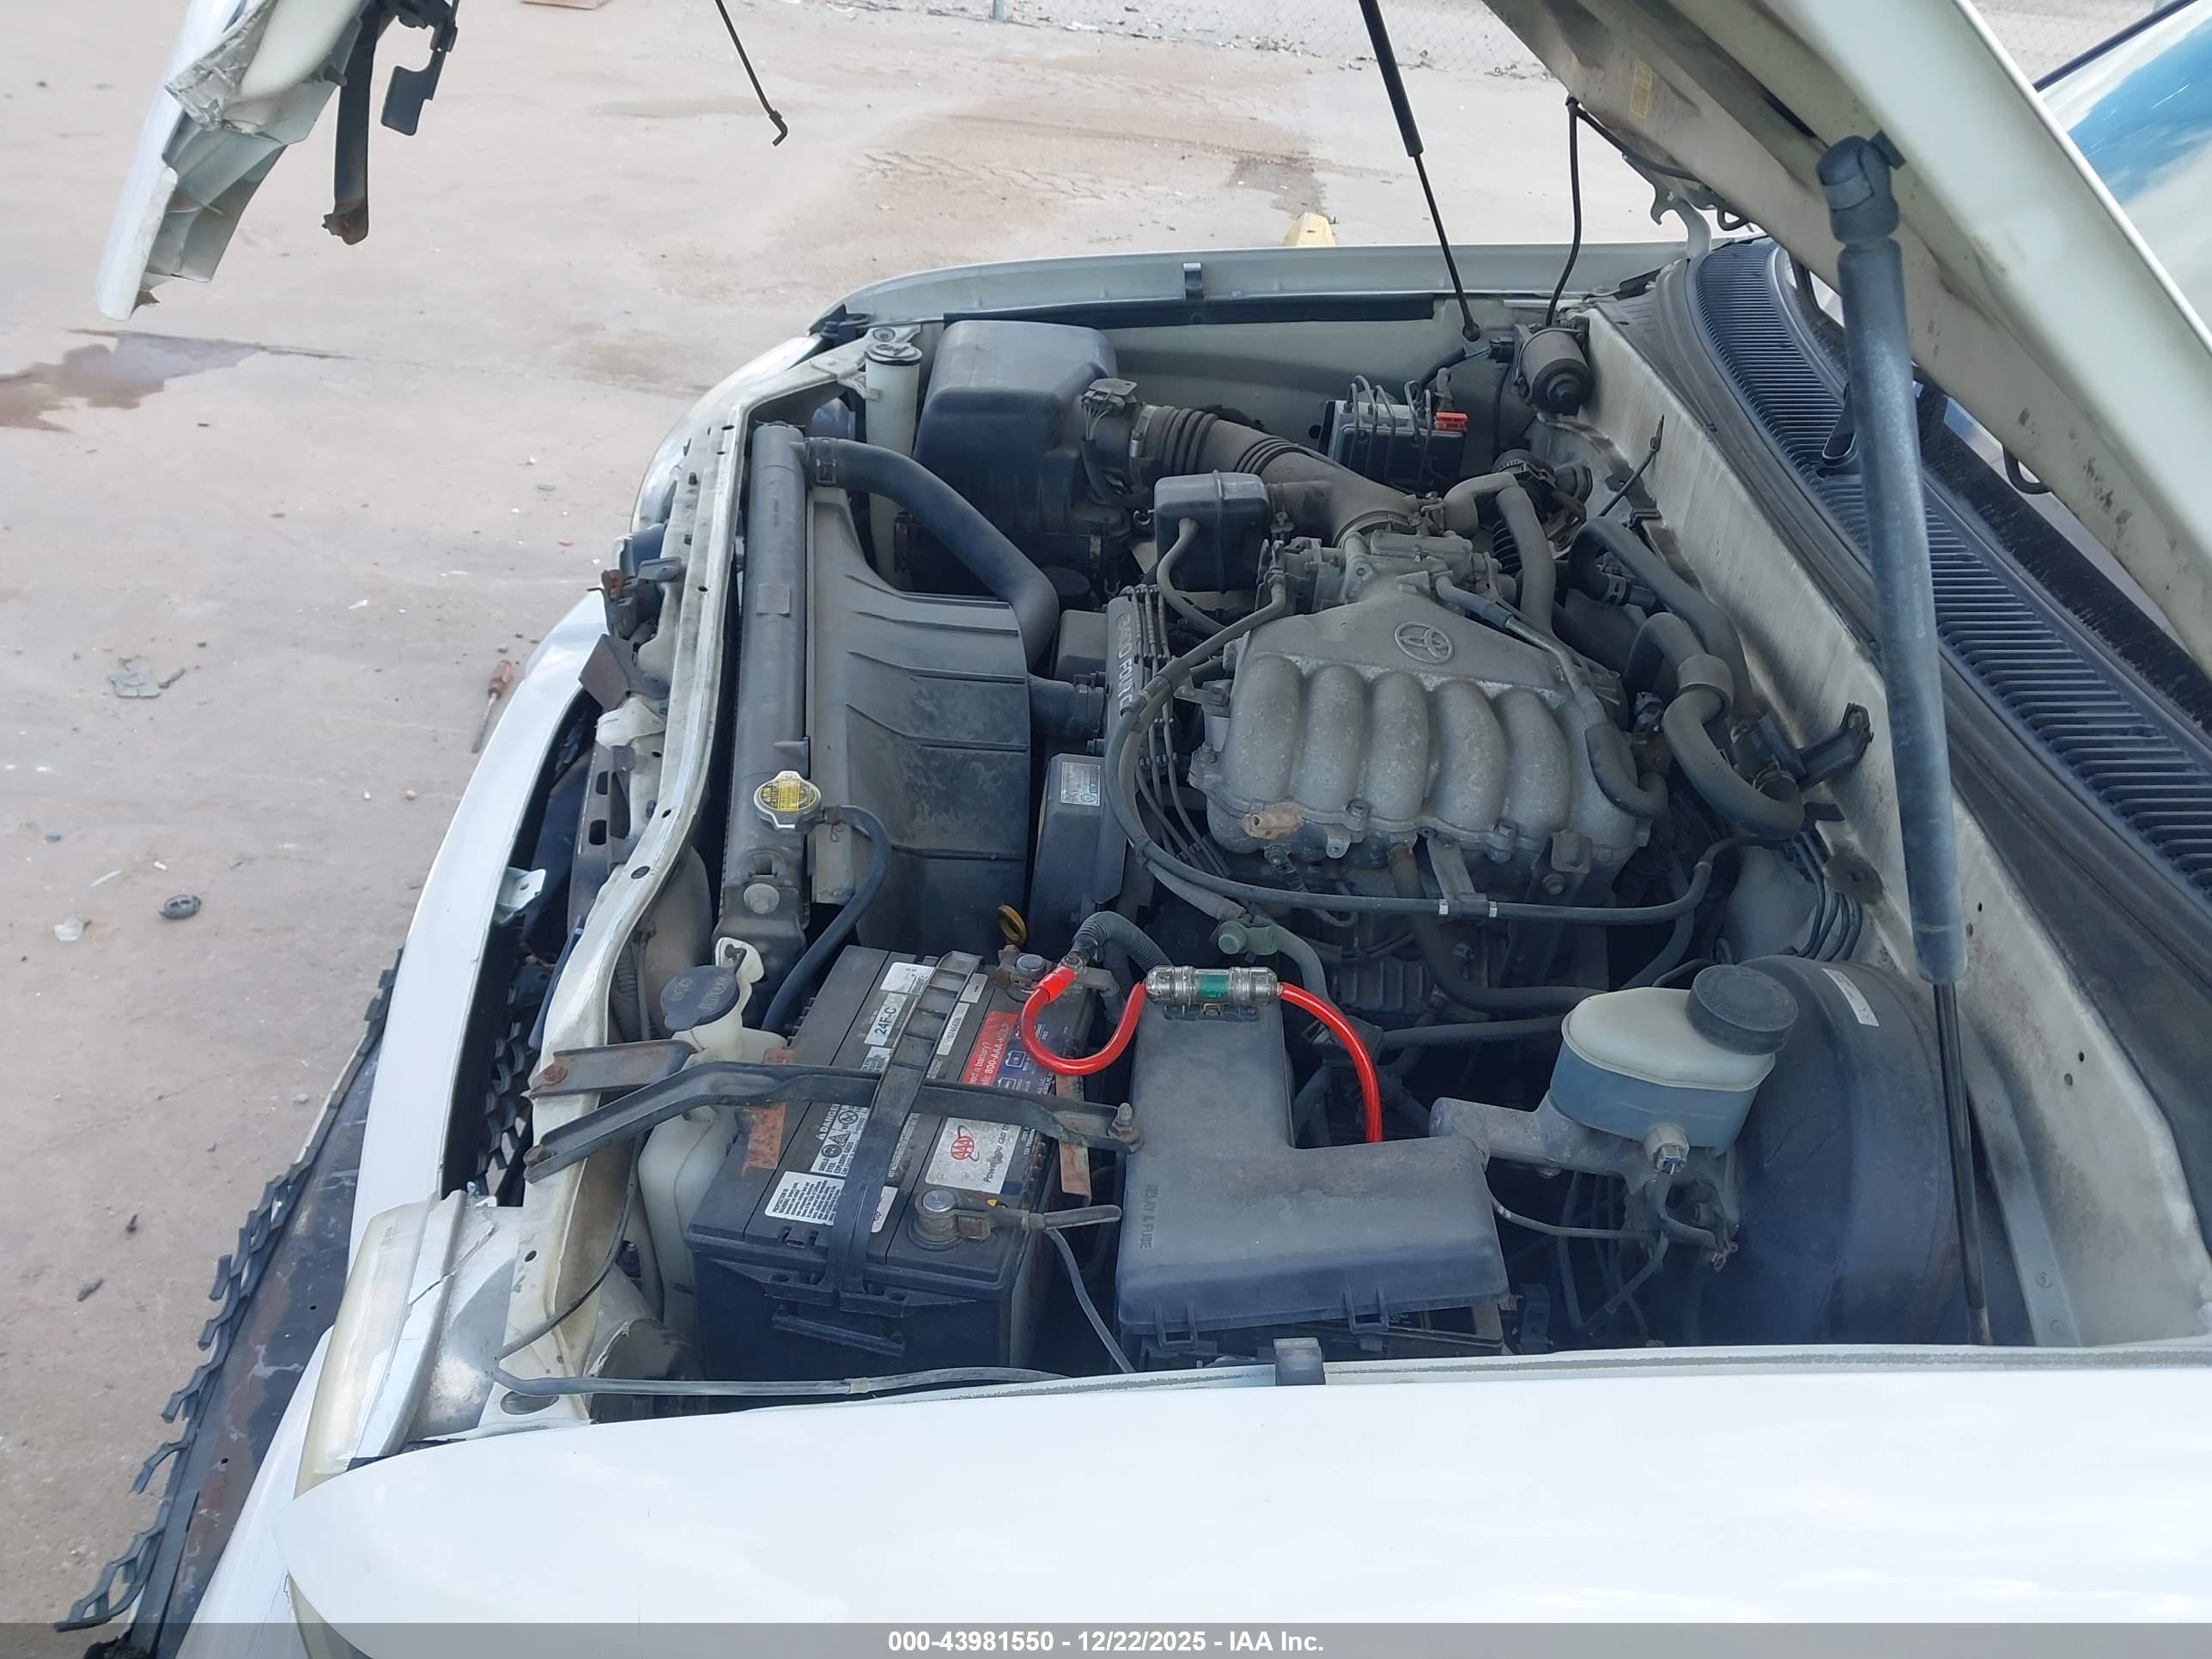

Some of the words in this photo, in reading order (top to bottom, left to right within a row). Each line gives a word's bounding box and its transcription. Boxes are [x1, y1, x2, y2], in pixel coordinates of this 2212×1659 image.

[1118, 658, 1133, 697] FOUR
[873, 1006, 896, 1035] 24F-C
[969, 1073, 978, 1084] eed
[974, 1041, 991, 1066] battery?
[981, 1074, 990, 1085] all:
[951, 1136, 971, 1156] AAA
[997, 1132, 1007, 1144] can
